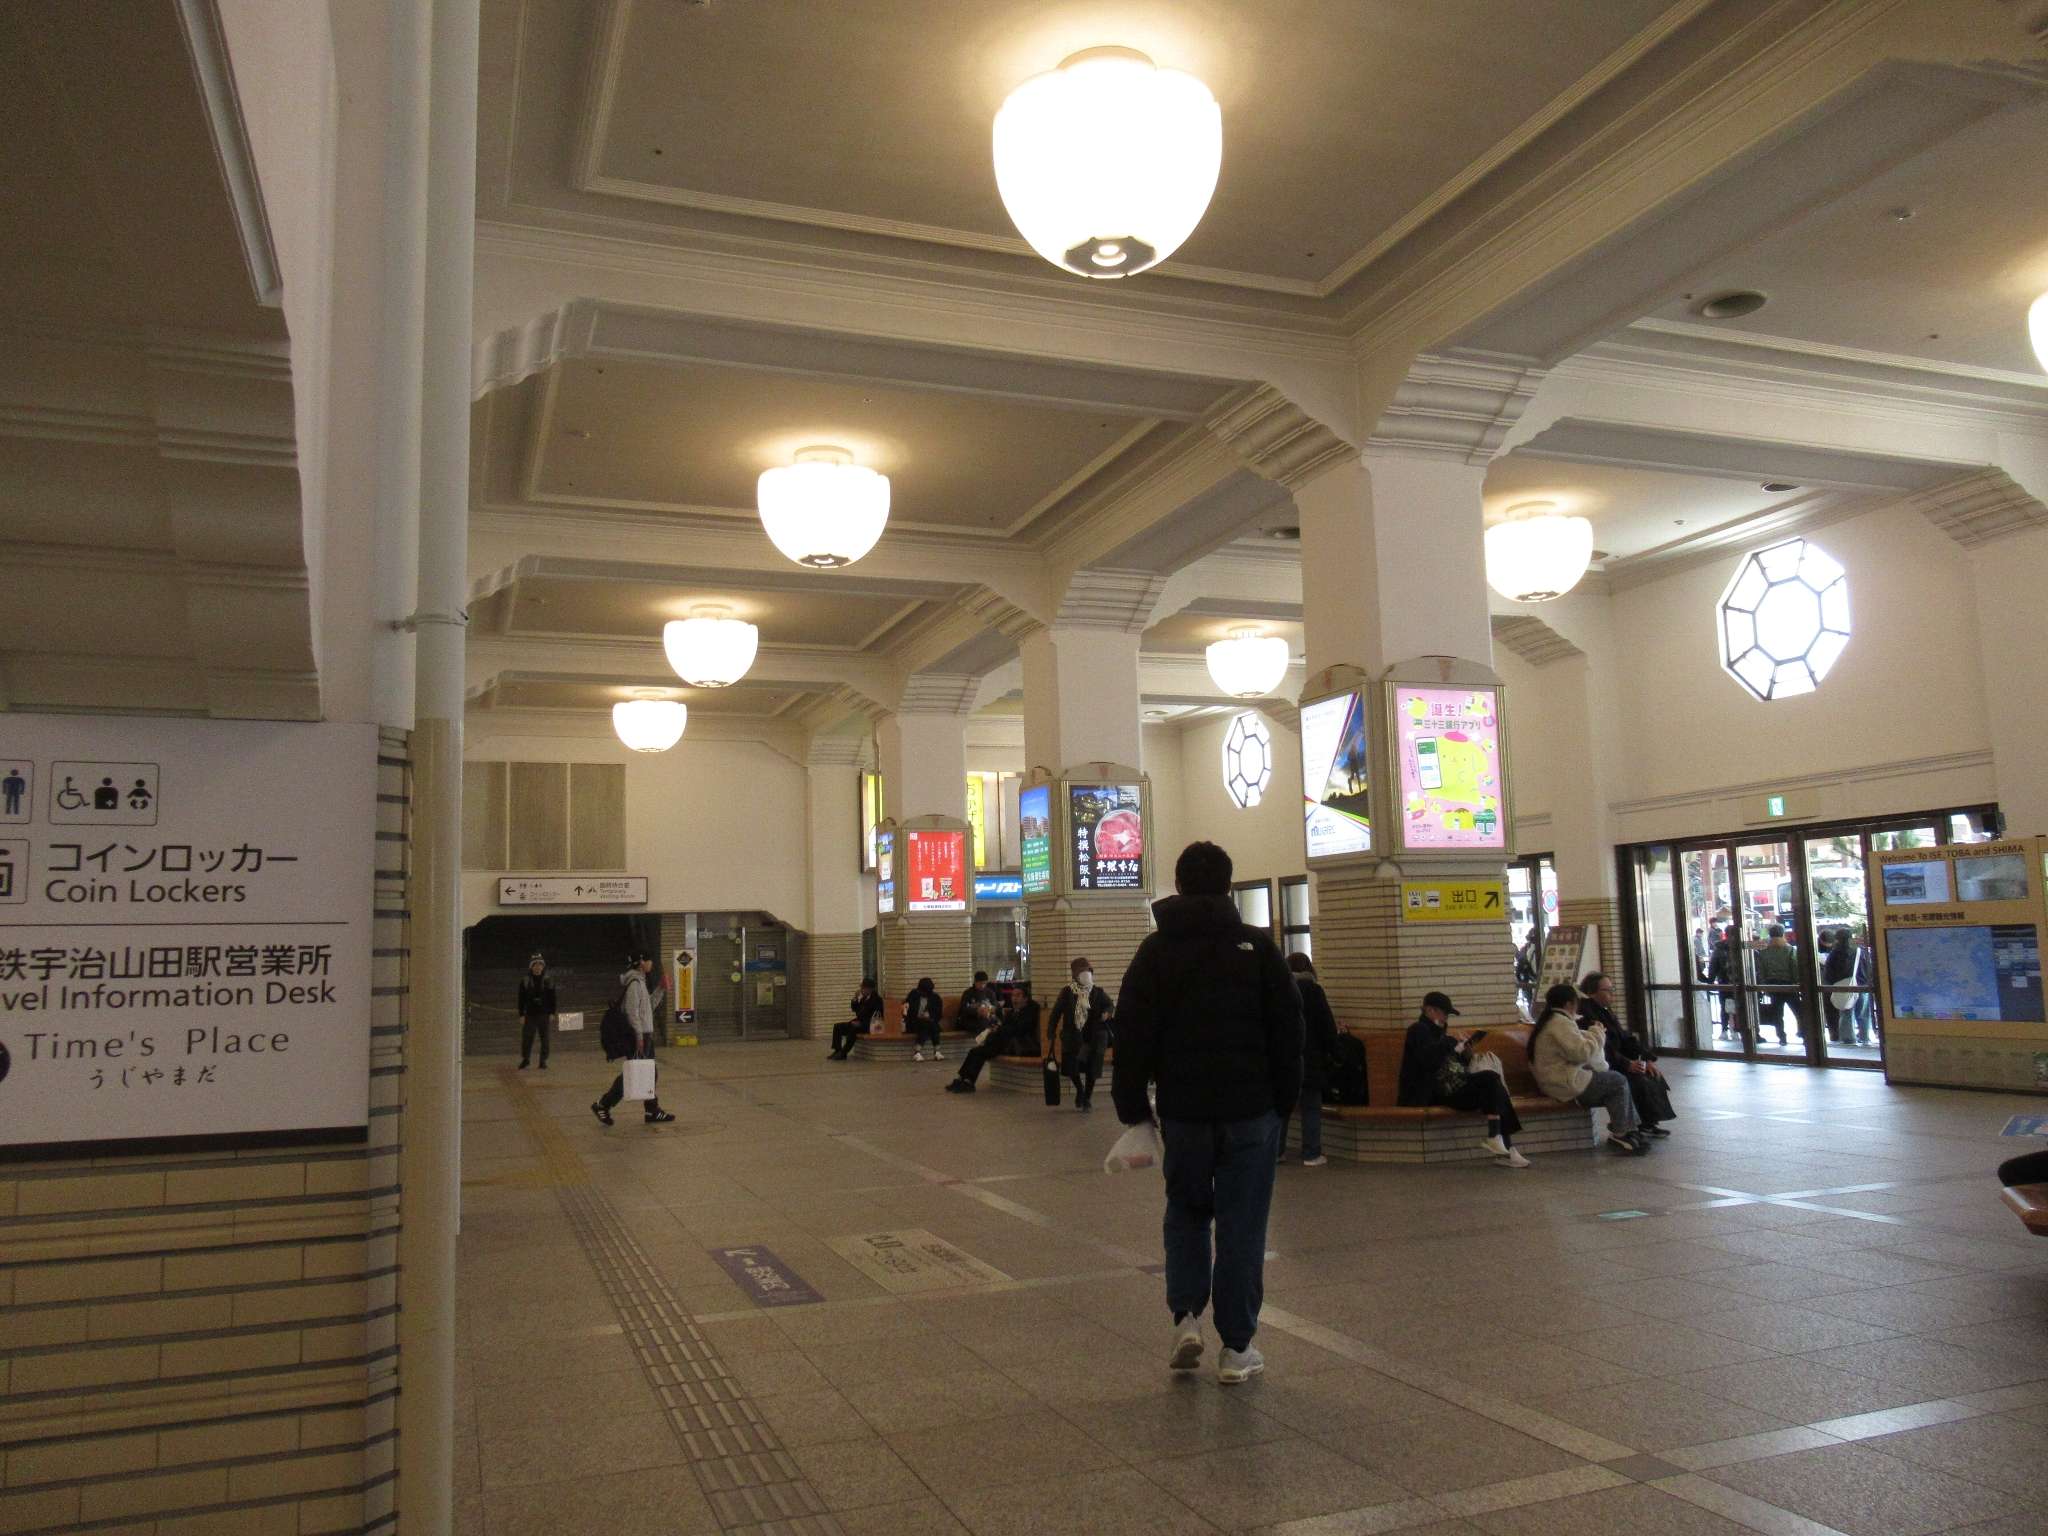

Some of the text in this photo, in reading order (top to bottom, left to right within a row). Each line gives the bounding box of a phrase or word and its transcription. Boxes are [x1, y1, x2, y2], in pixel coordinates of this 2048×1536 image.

[47, 843, 299, 873] コインロッカー
[1879, 854, 1916, 864] Welcome
[1946, 849, 1971, 858] TOBA
[1974, 848, 1991, 856] and
[1993, 845, 2025, 855] SHIMA
[46, 878, 247, 904] Coin Lockers
[1452, 889, 1477, 903] 出口
[60, 981, 254, 1011] Information
[266, 979, 337, 1006] Desk
[23, 1026, 290, 1060] Time's Place
[90, 1065, 217, 1090] うじやまだ
